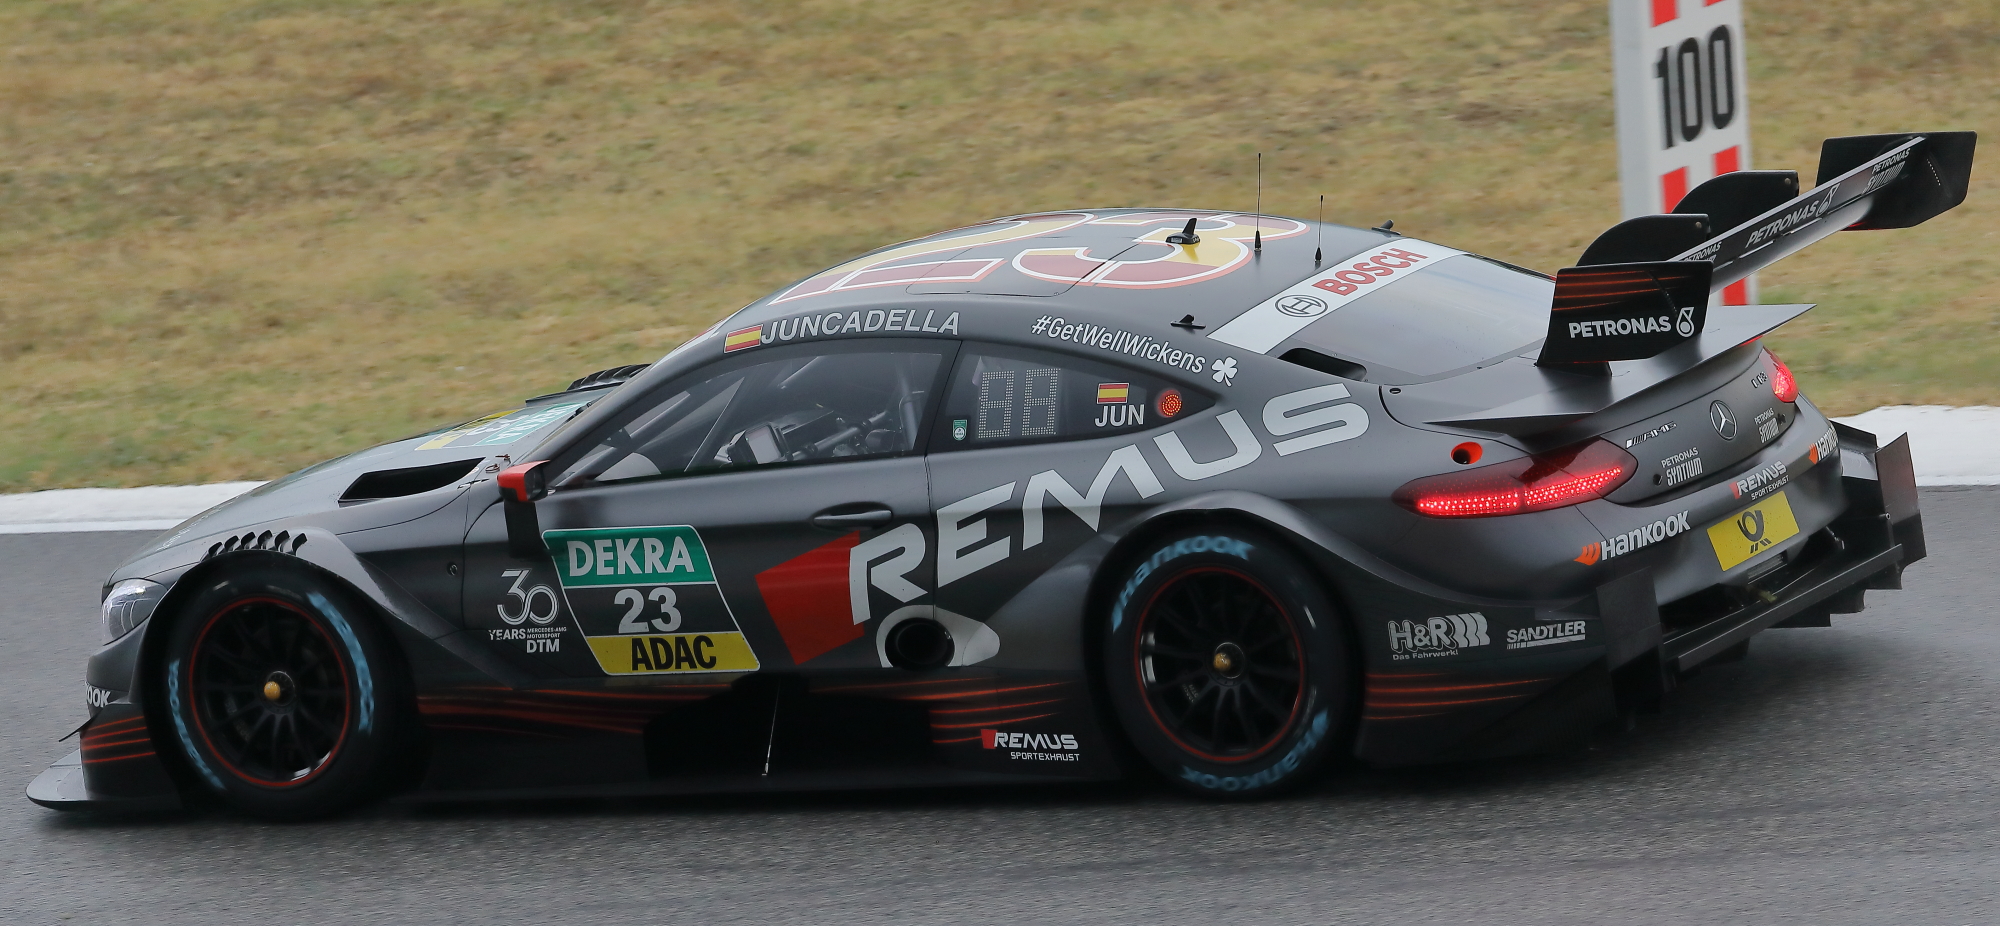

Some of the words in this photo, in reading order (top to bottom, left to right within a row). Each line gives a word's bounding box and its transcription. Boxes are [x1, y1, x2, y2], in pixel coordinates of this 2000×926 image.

[1654, 24, 1735, 150] 100
[1745, 200, 1820, 249] PETRONAS
[1312, 248, 1429, 296] BOSCH
[761, 309, 960, 345] JUNCADELLA
[1031, 315, 1206, 374] #GetWellWickens
[1568, 315, 1672, 339] PETRONAS
[1095, 403, 1145, 427] JUN
[1661, 447, 1699, 468] PETRONAS
[1666, 457, 1703, 487] SYNTIUM
[1736, 460, 1787, 496] REMUS
[1750, 474, 1790, 500] SPORTEXHAUST
[849, 383, 1371, 626] REMUS
[566, 536, 695, 577] DEKRA
[497, 568, 560, 626] 30
[613, 586, 682, 634] 23
[488, 628, 527, 641] YEARS
[526, 639, 560, 654] DTM
[1388, 616, 1457, 653] H&R
[1506, 620, 1586, 644] SANDTLER
[631, 635, 717, 671] ADAC
[994, 732, 1079, 751] REMUS
[1010, 751, 1080, 761] SPORTEXHAUST
